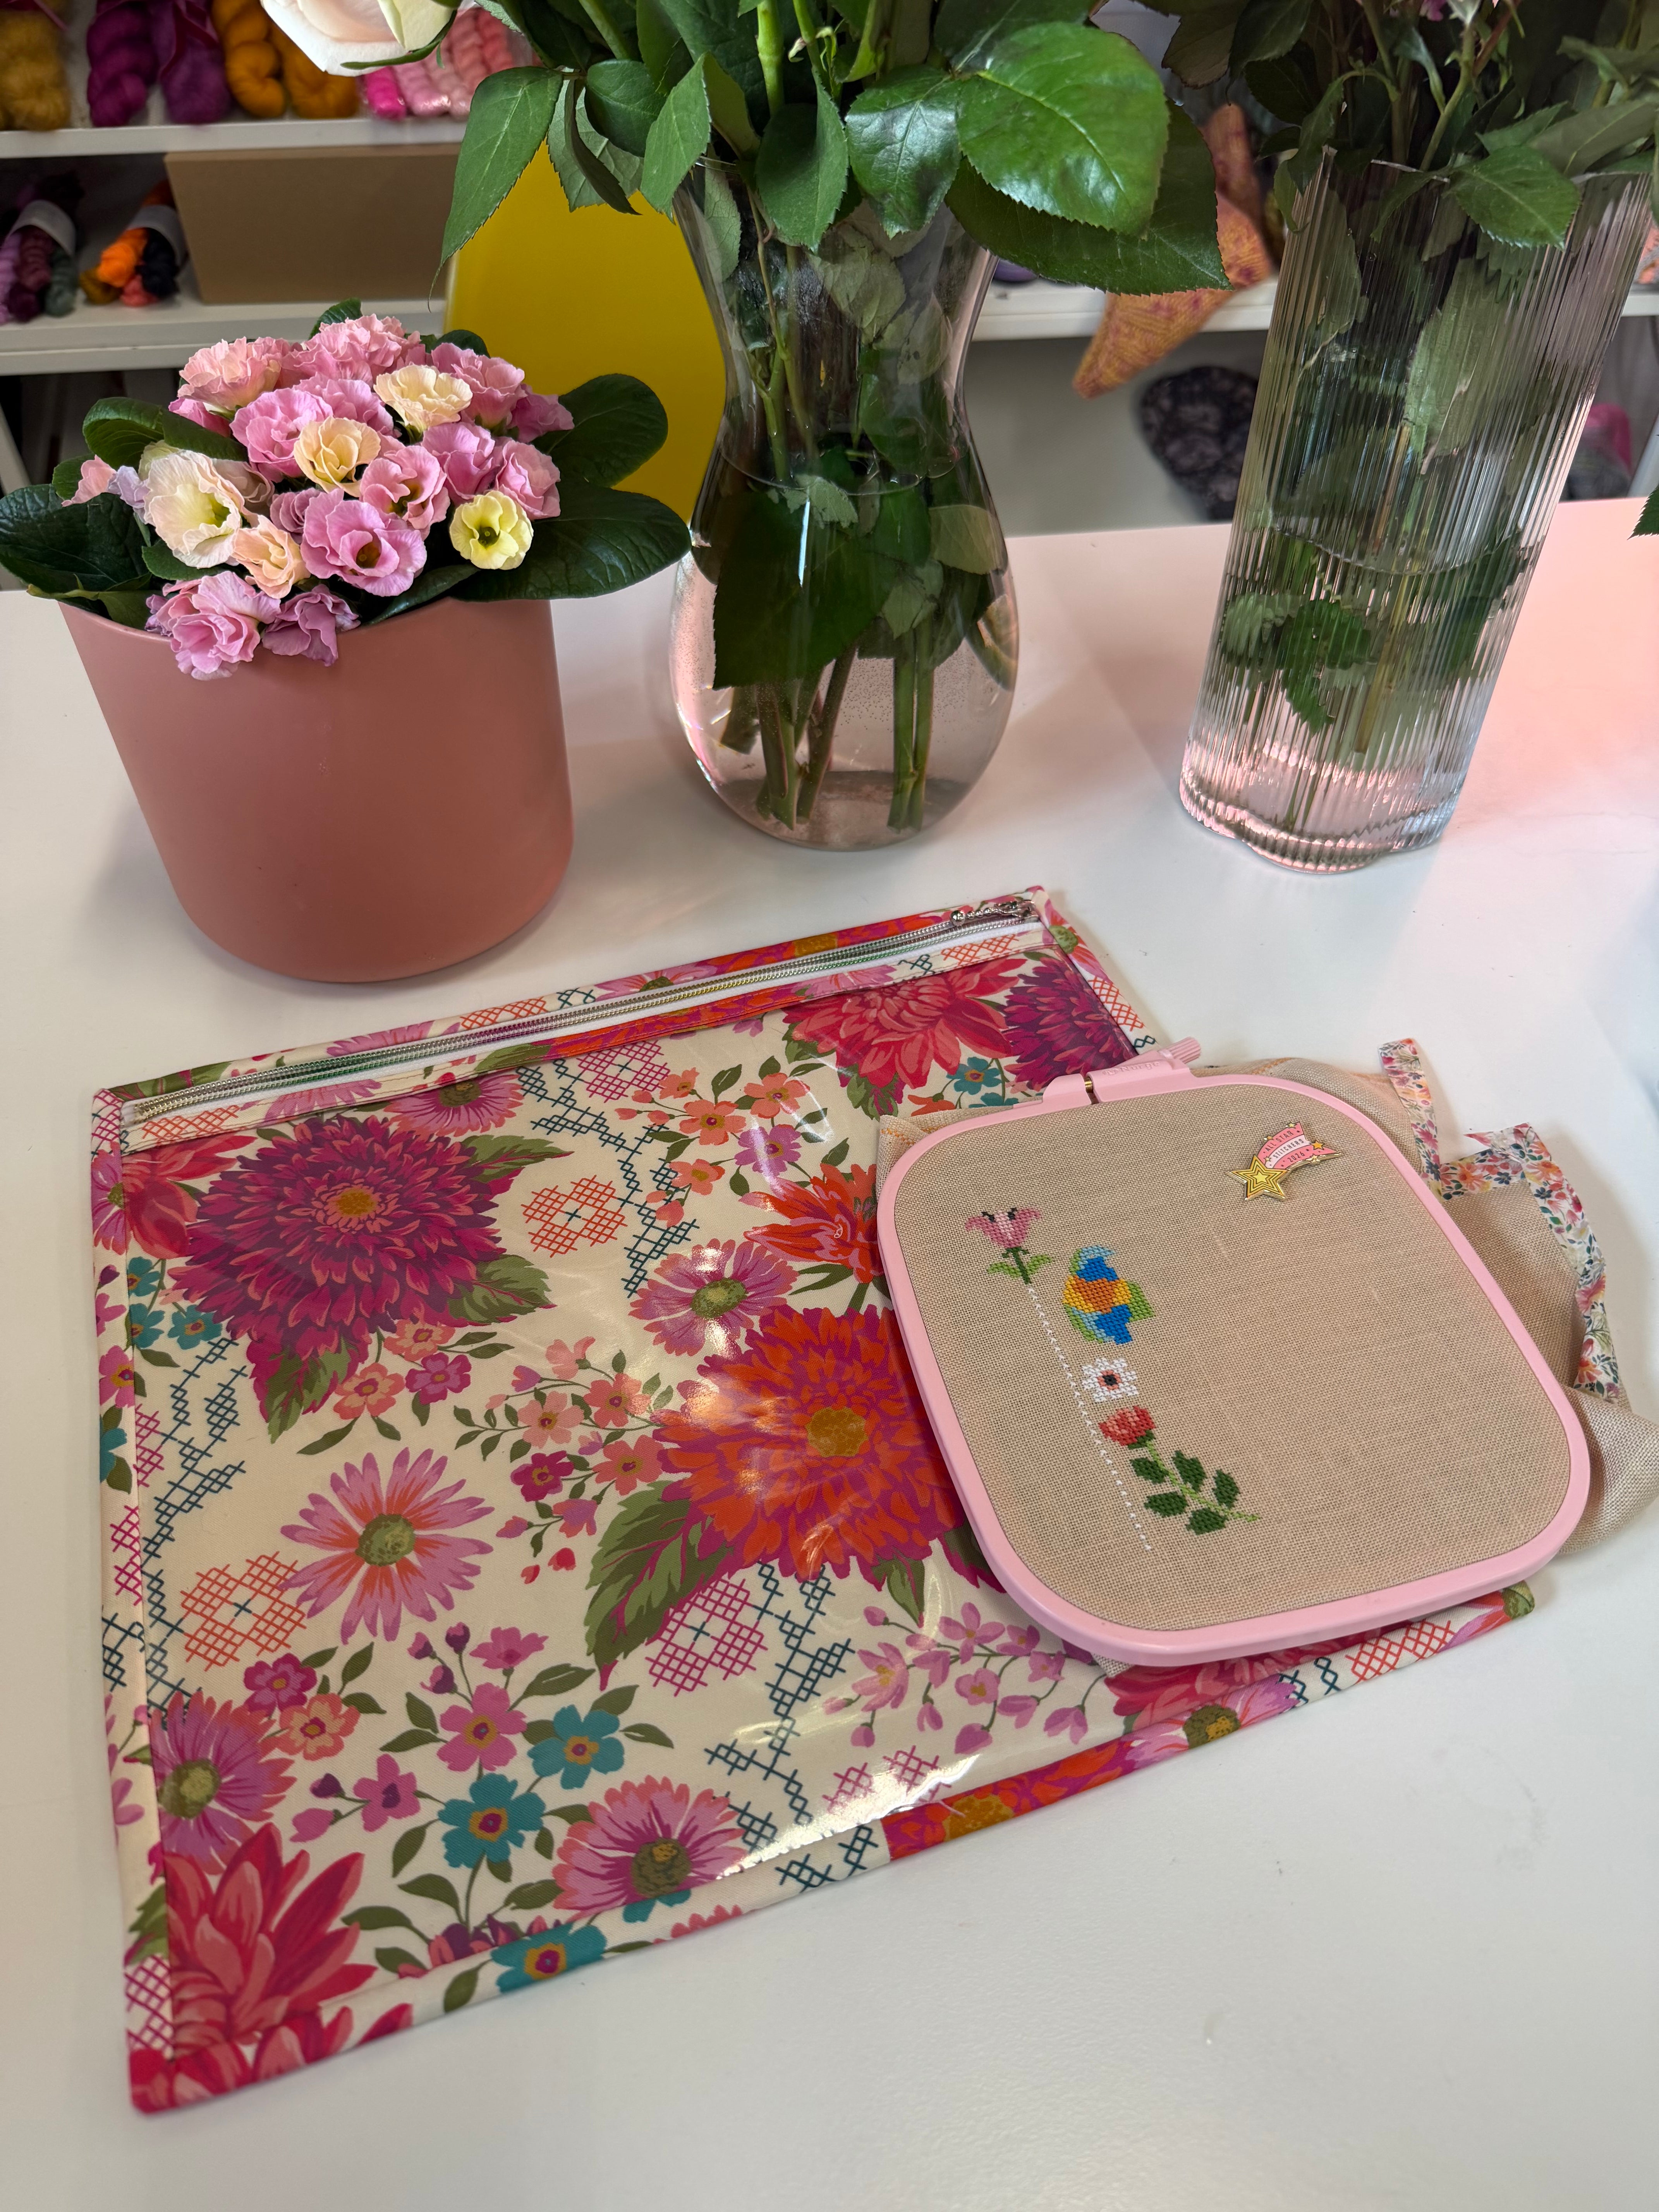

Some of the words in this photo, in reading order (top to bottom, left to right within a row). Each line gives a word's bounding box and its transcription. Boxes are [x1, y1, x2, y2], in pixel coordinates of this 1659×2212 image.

[1119, 1061, 1159, 1072] Nurge
[1265, 1142, 1276, 1151] ALL
[1276, 1130, 1293, 1142] STAR
[1273, 1139, 1304, 1159] STITCHERS
[1287, 1151, 1305, 1162] 2026
